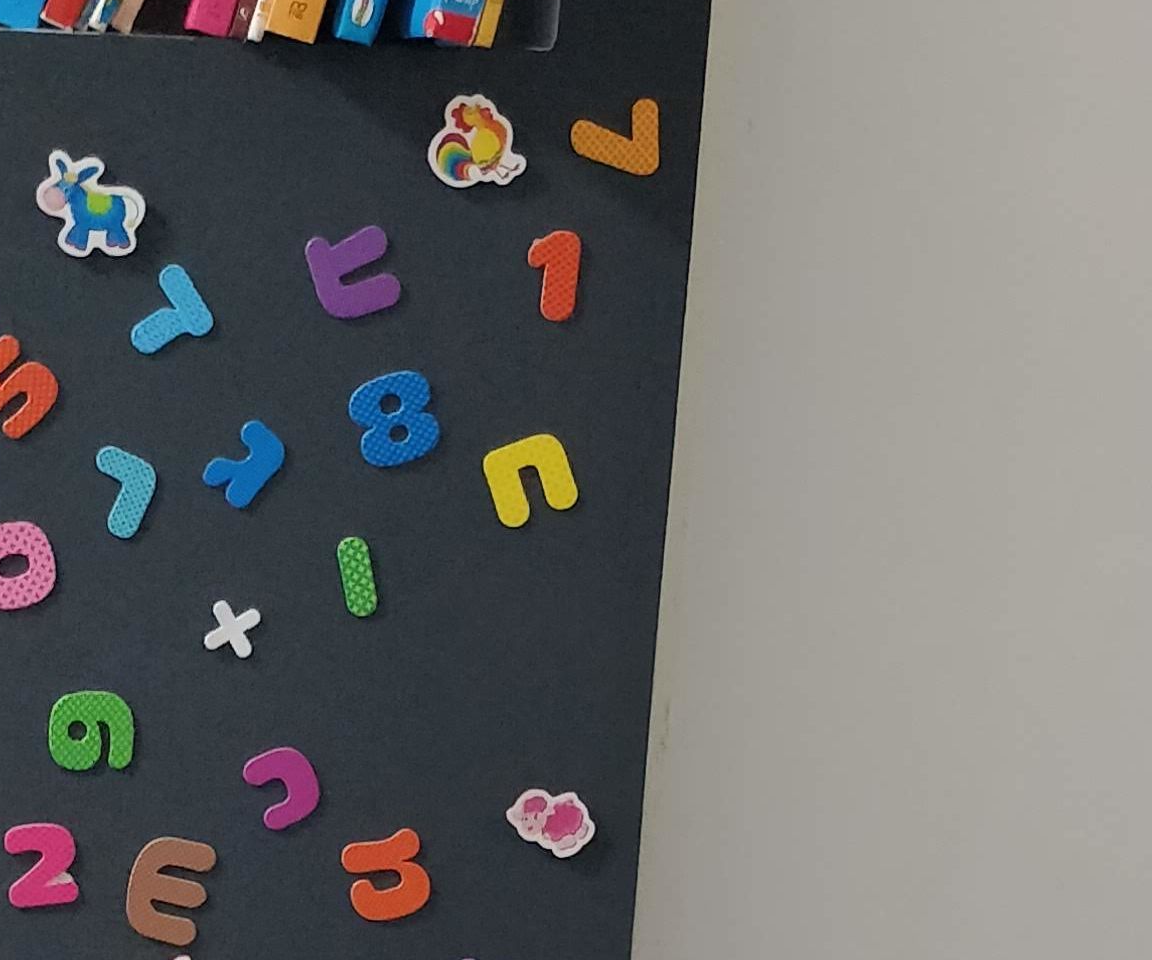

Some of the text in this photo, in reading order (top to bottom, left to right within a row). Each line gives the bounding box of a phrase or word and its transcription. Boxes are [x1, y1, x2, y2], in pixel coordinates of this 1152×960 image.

[528, 229, 582, 322] 1
[348, 369, 440, 468] 8
[3, 822, 80, 909] 2
